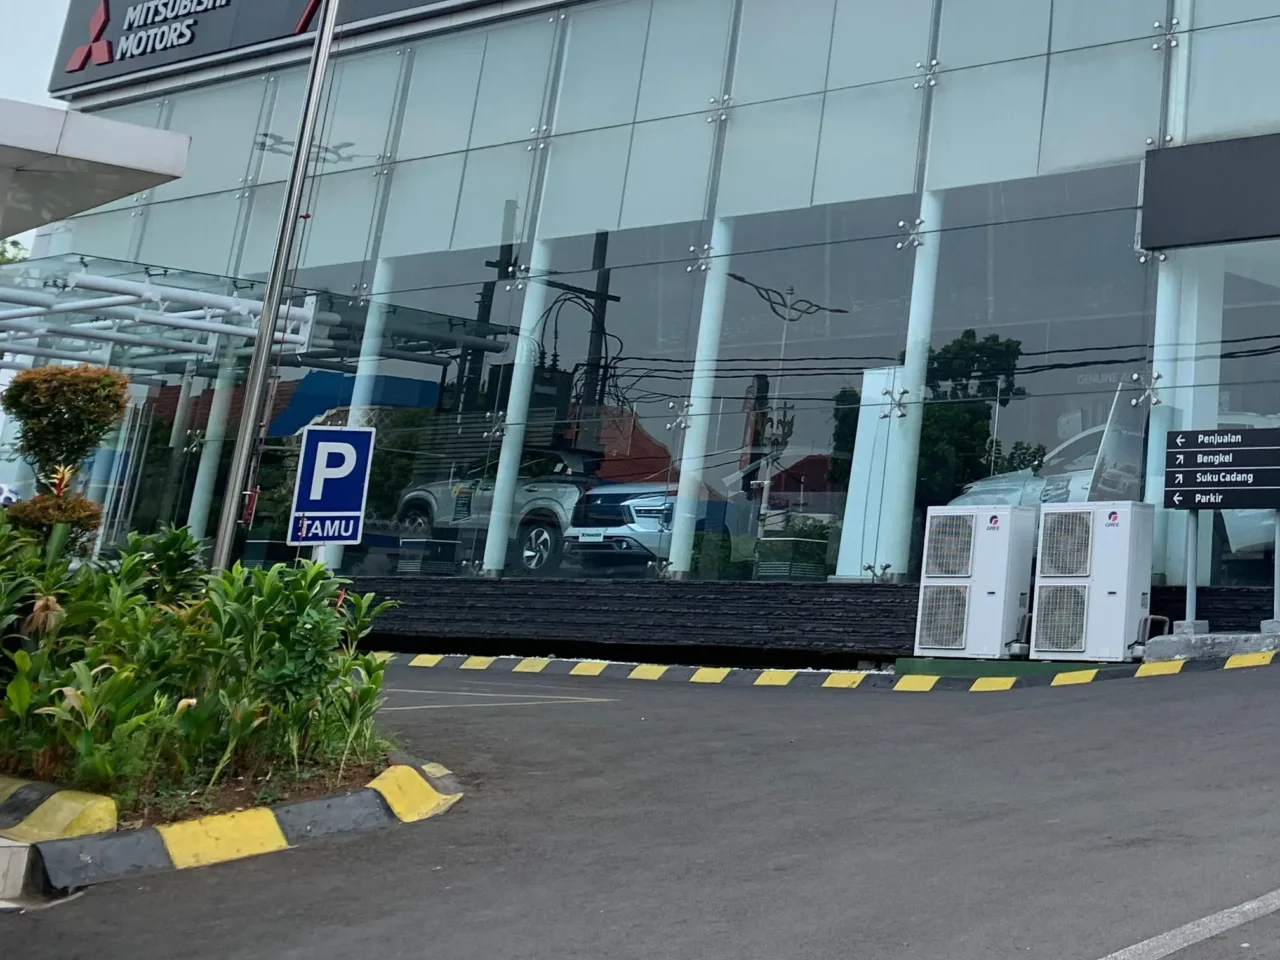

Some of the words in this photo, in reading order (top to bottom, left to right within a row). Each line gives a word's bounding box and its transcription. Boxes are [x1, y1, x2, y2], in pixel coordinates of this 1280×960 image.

[115, 19, 198, 61] MOTORS
[1197, 433, 1242, 445] Penjualan
[1196, 453, 1233, 465] Bengkel
[309, 441, 357, 500] P
[1196, 472, 1218, 482] Suku
[1219, 472, 1254, 483] Cadang
[1195, 493, 1223, 503] Parkir
[300, 520, 354, 537] TAMU
